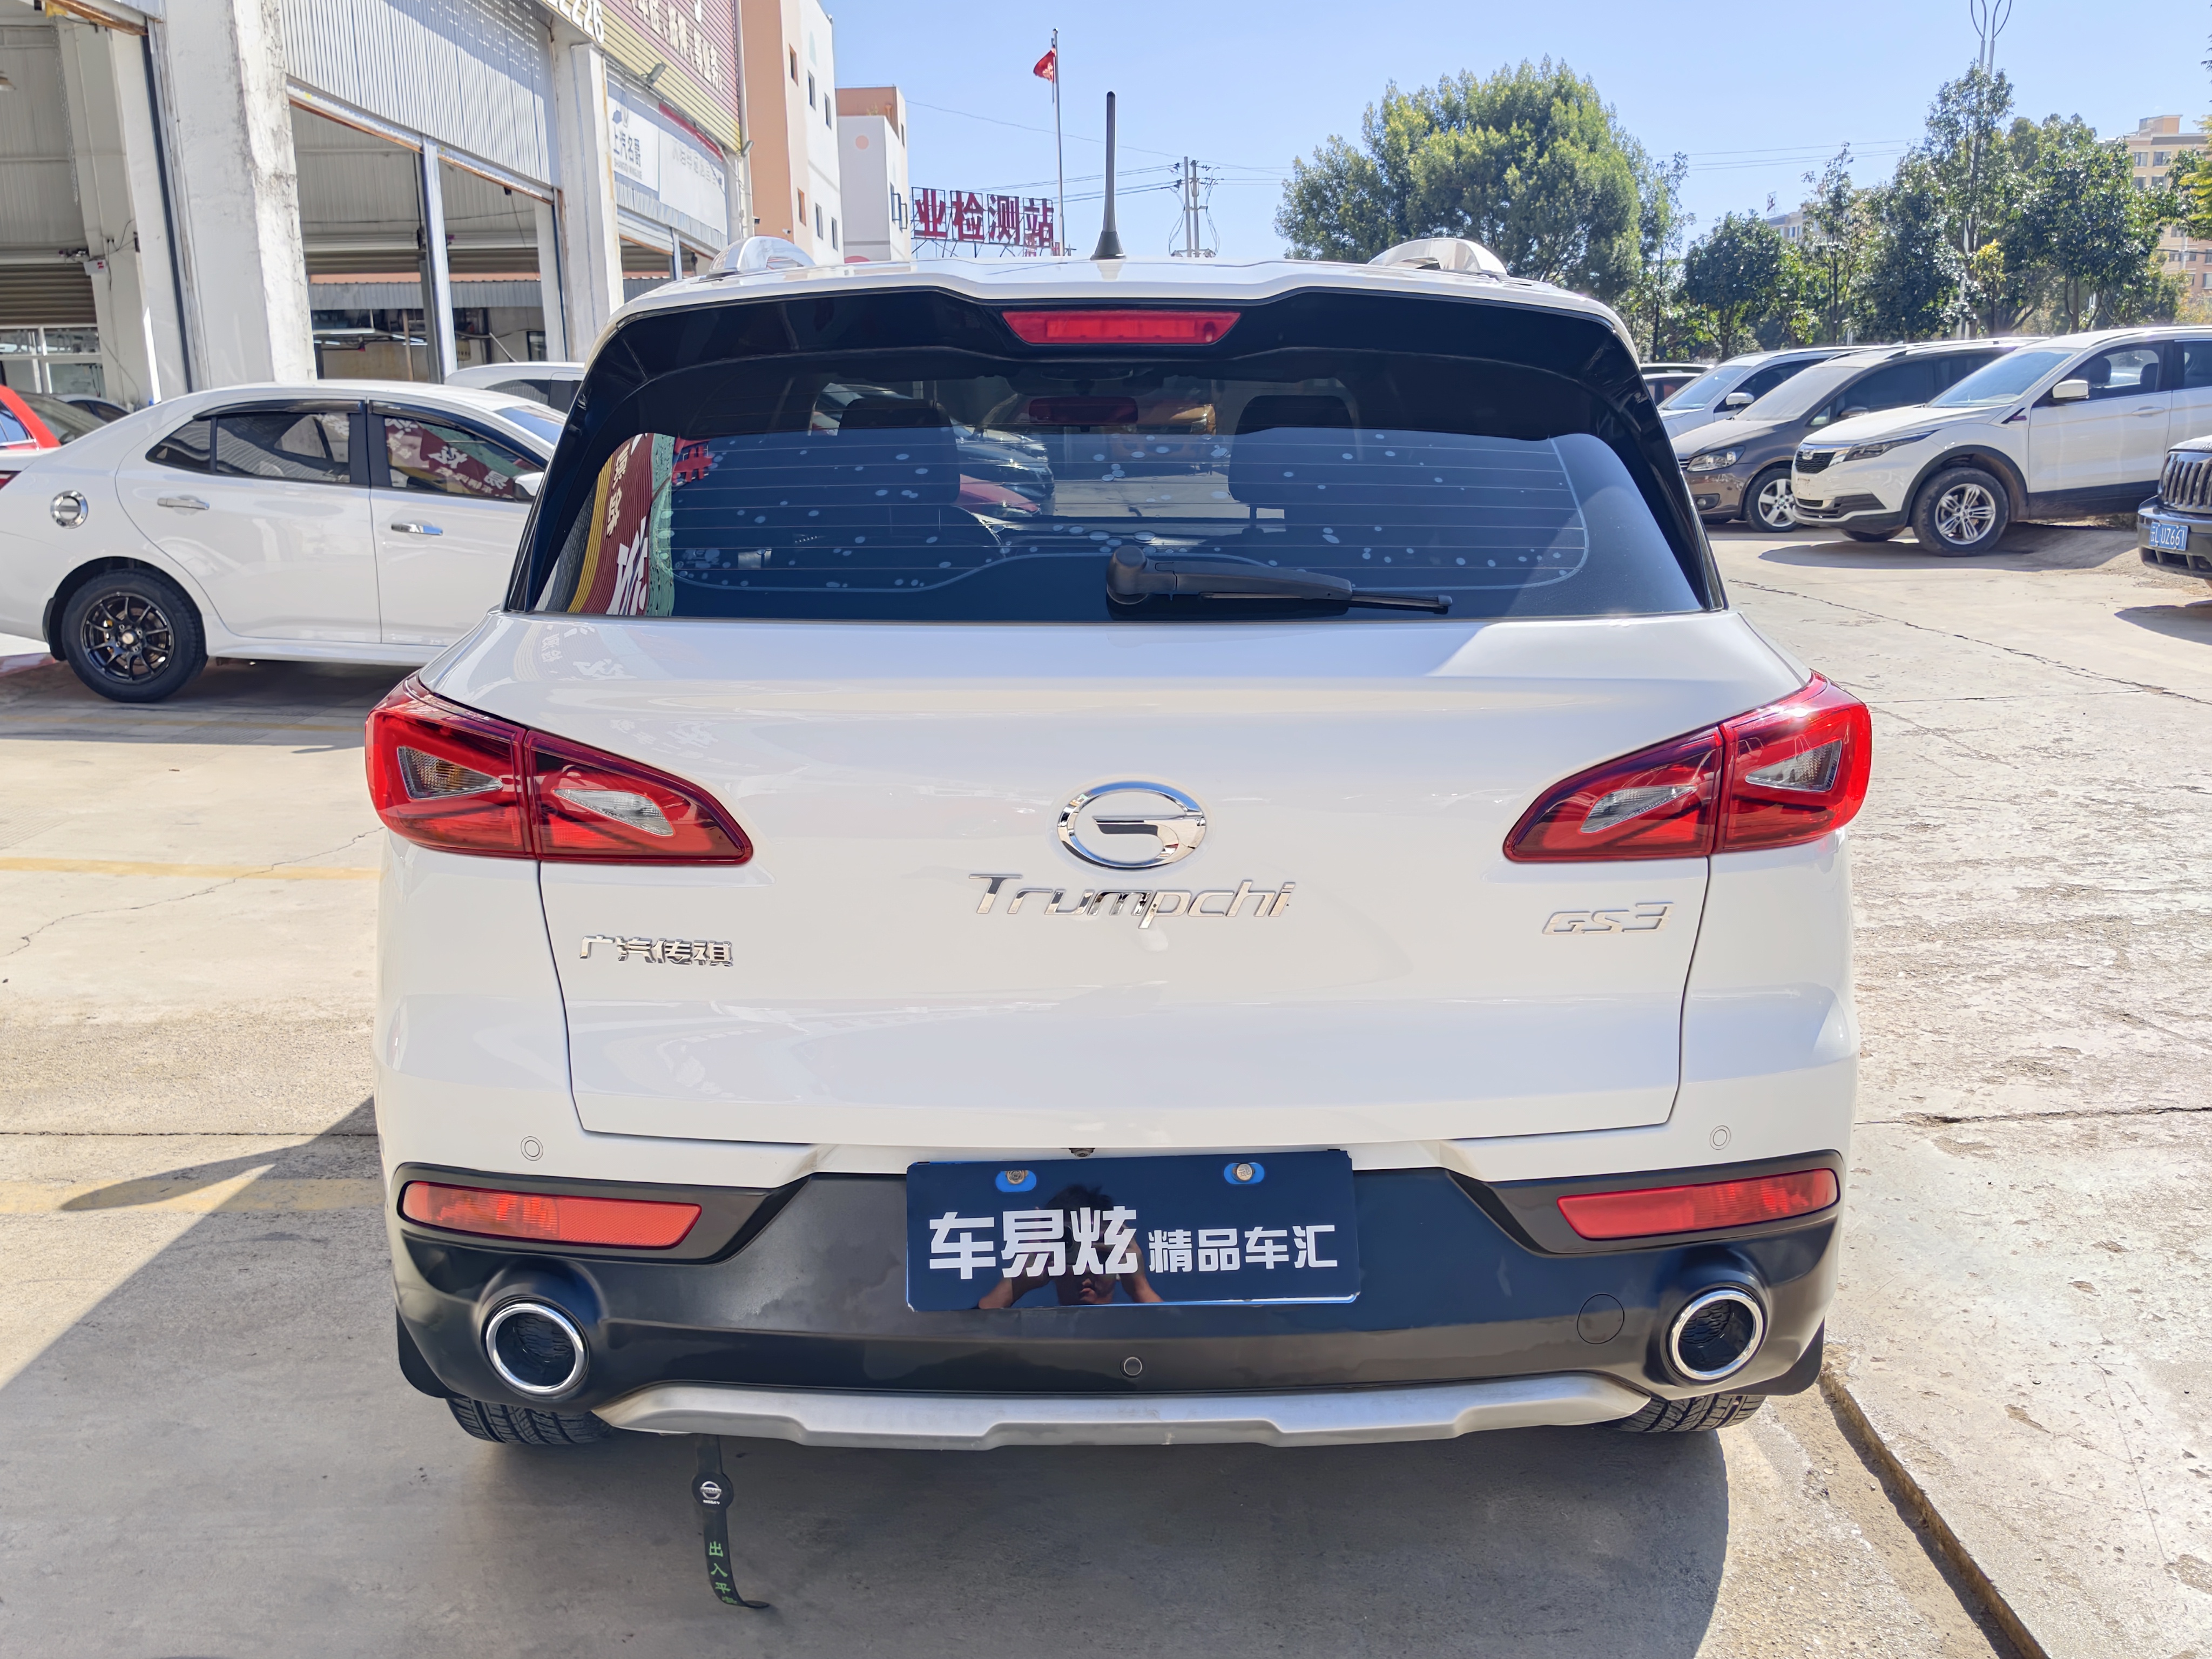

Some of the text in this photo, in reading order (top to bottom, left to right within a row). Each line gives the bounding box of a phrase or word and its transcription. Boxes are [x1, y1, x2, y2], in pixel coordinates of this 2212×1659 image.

[915, 189, 1054, 248] 业检测站
[969, 874, 1296, 929] Trumpchi
[1542, 901, 1675, 935] GS3
[579, 934, 733, 967] 广汽传祺
[929, 1205, 1338, 1280] 车易炫 精品车汇
